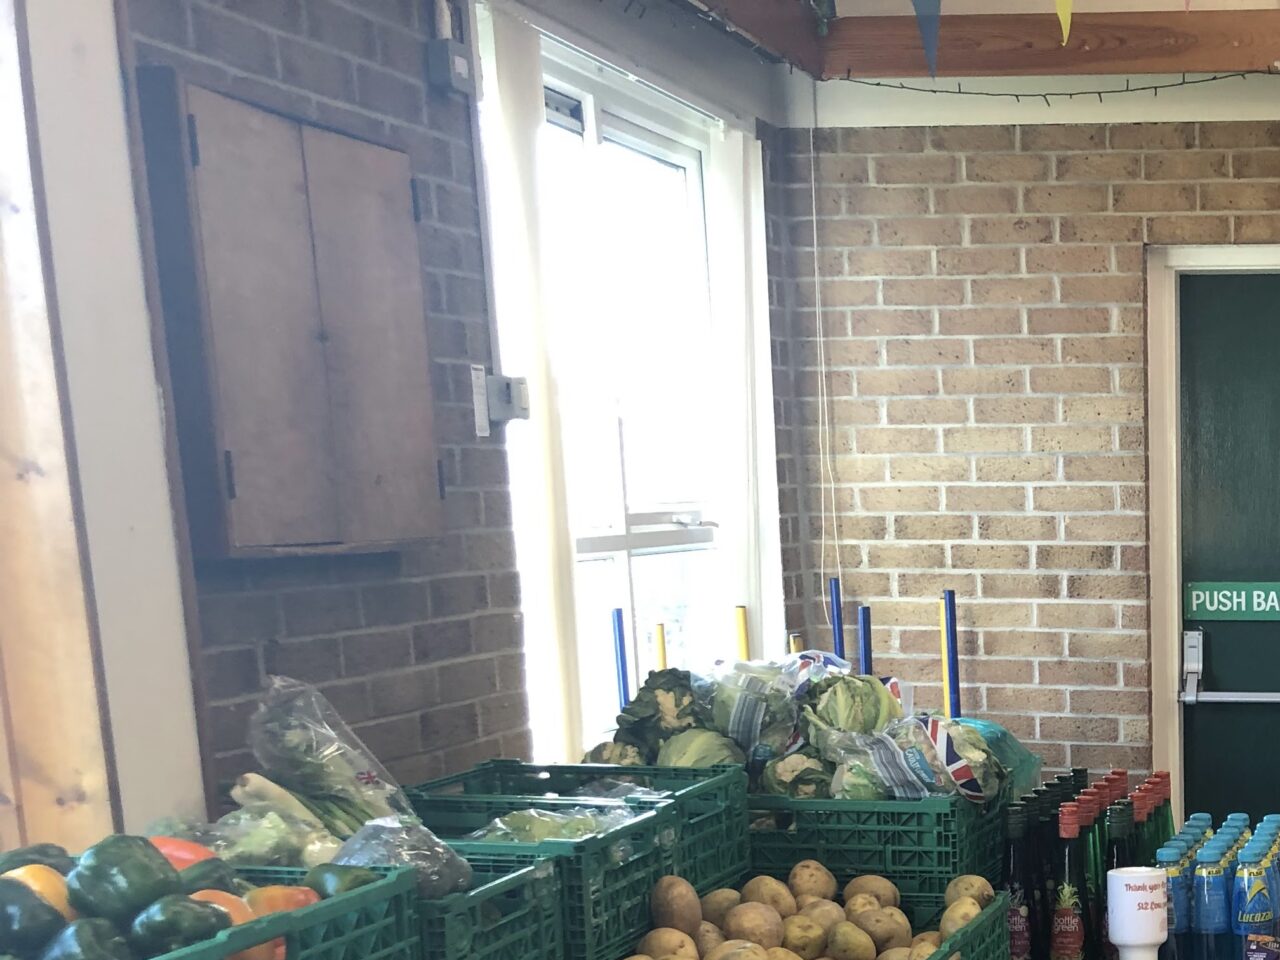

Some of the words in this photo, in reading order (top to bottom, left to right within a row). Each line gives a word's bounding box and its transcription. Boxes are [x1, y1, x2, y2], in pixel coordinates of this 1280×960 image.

[1191, 591, 1246, 611] PUSH
[1125, 883, 1148, 892] Thank
[1054, 915, 1079, 925] bottle
[1054, 924, 1079, 934] green
